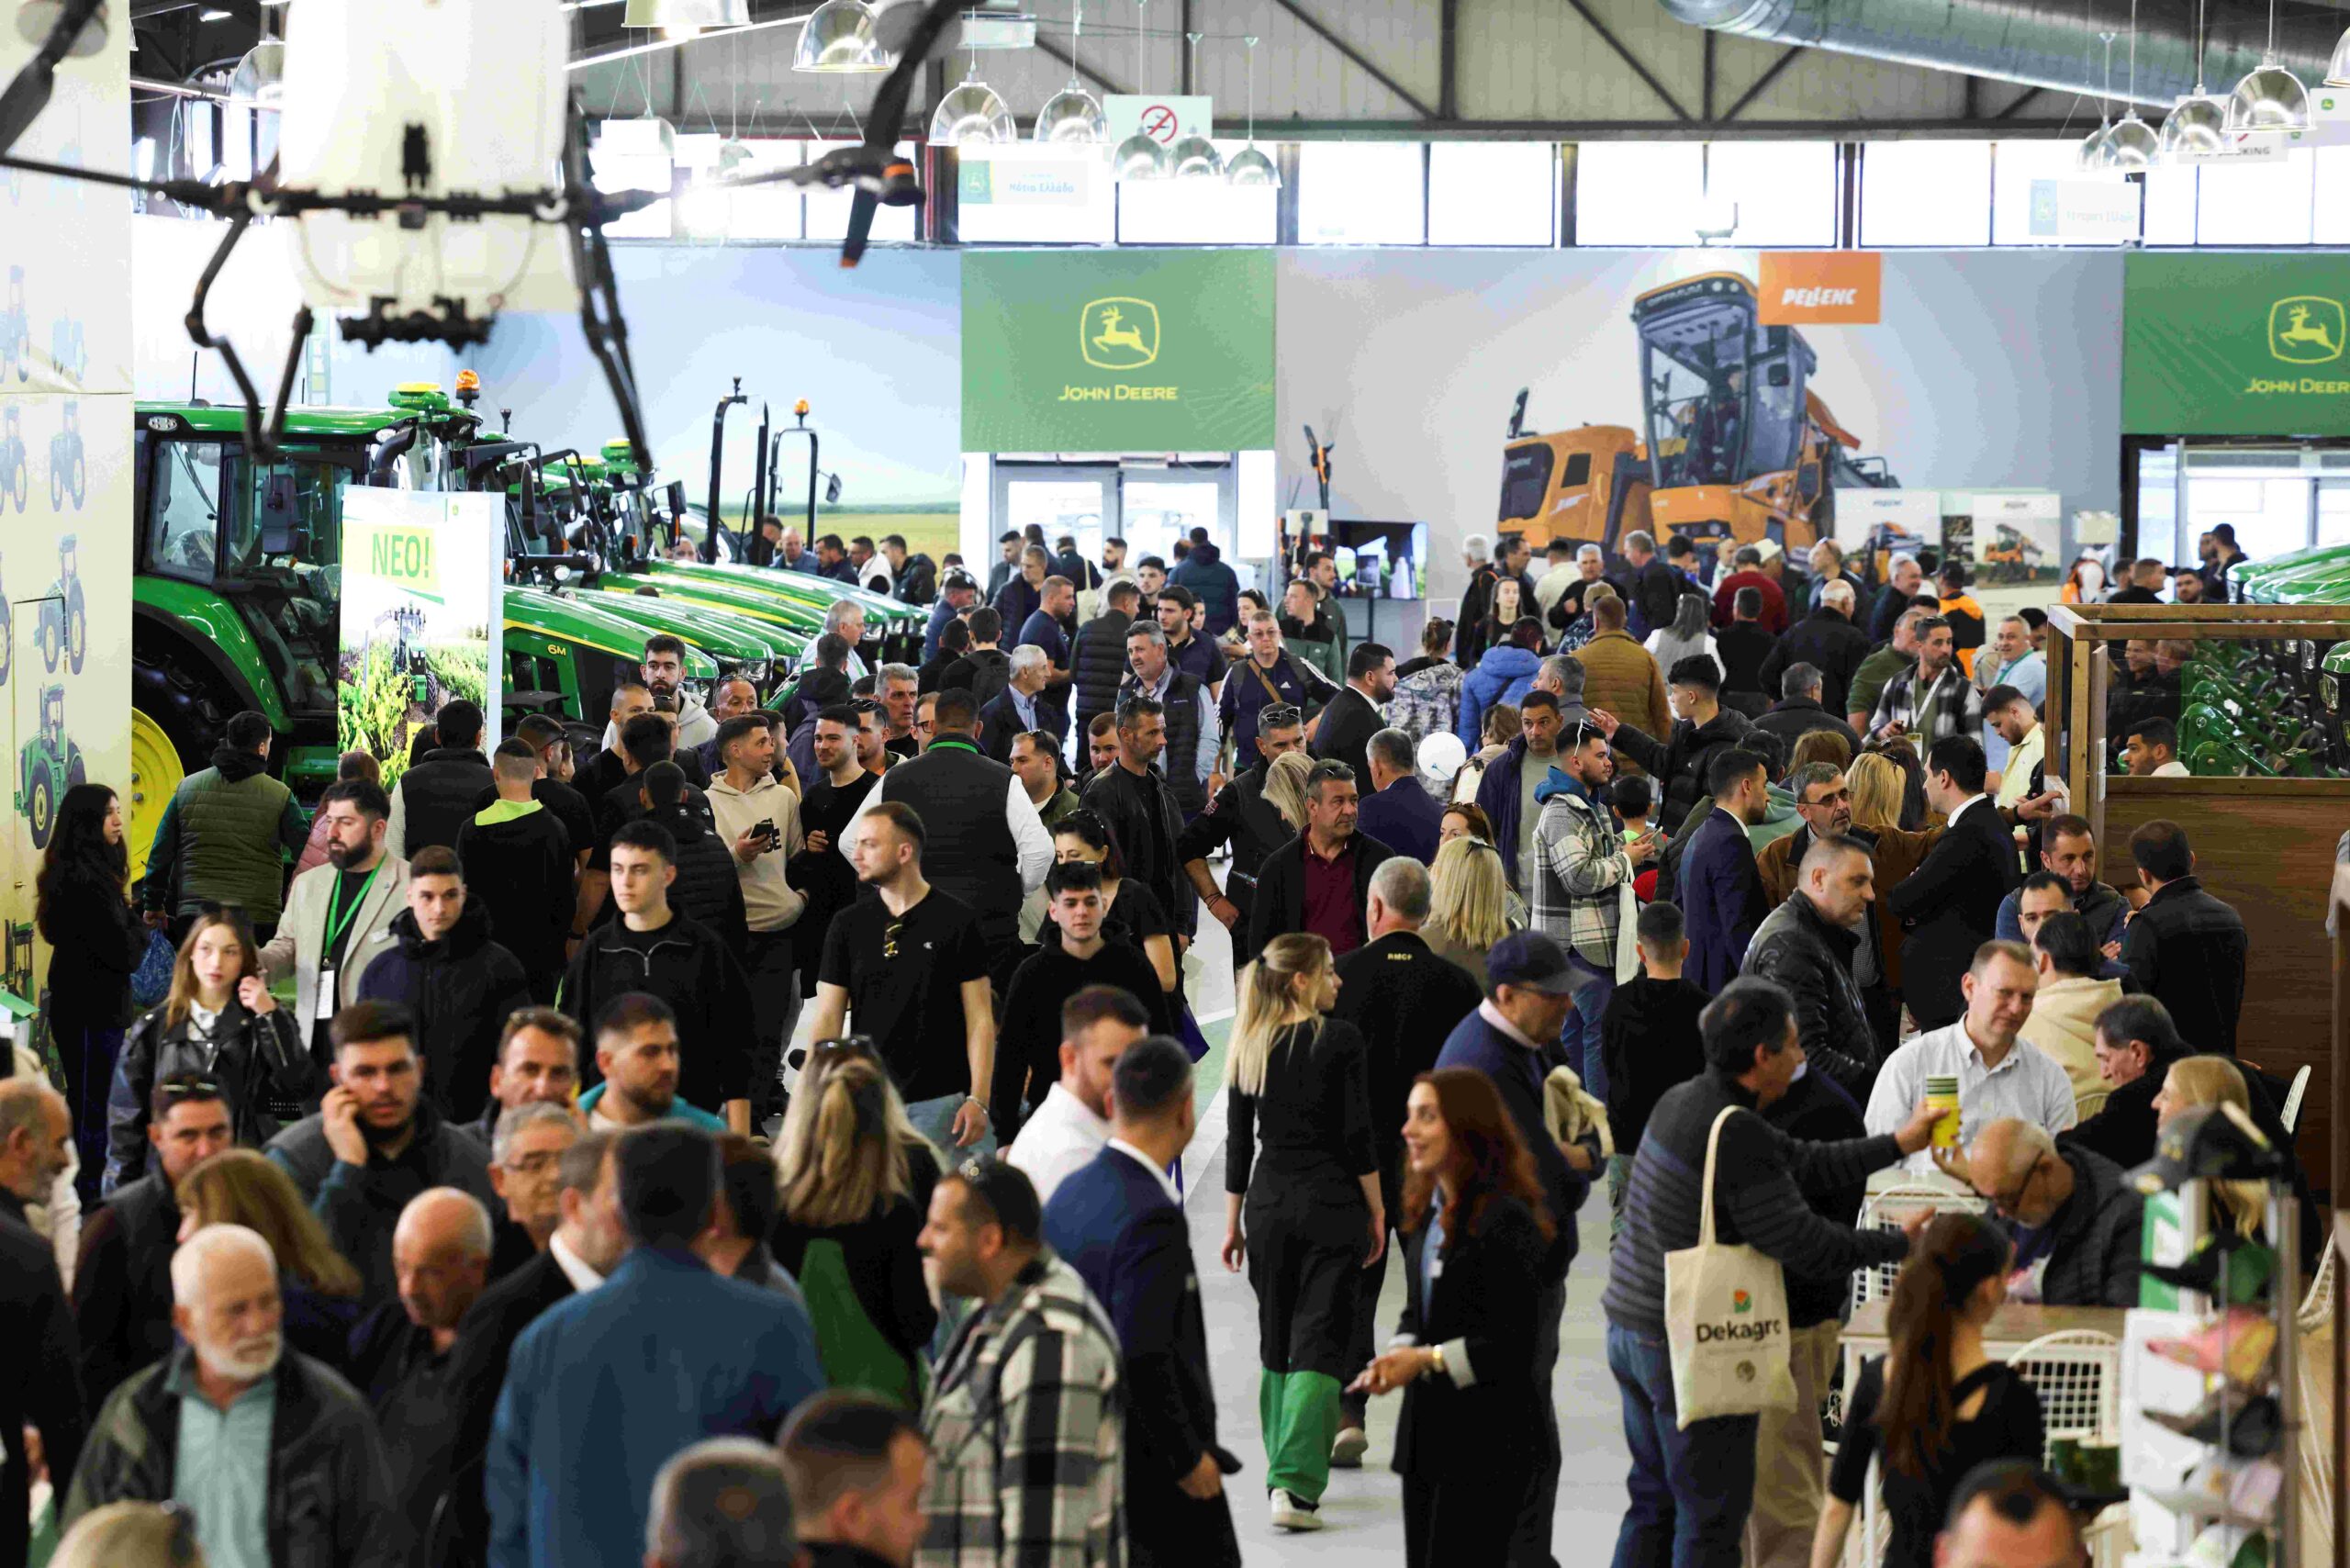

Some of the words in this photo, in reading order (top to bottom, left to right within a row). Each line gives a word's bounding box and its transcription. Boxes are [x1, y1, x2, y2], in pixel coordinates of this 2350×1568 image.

[1782, 286, 1857, 307] PELLENC
[1058, 385, 1110, 401] JOHN
[1114, 385, 1179, 401] DEERE
[2244, 377, 2296, 393] JOHN
[2300, 378, 2350, 394] DEER
[547, 644, 566, 655] 6M
